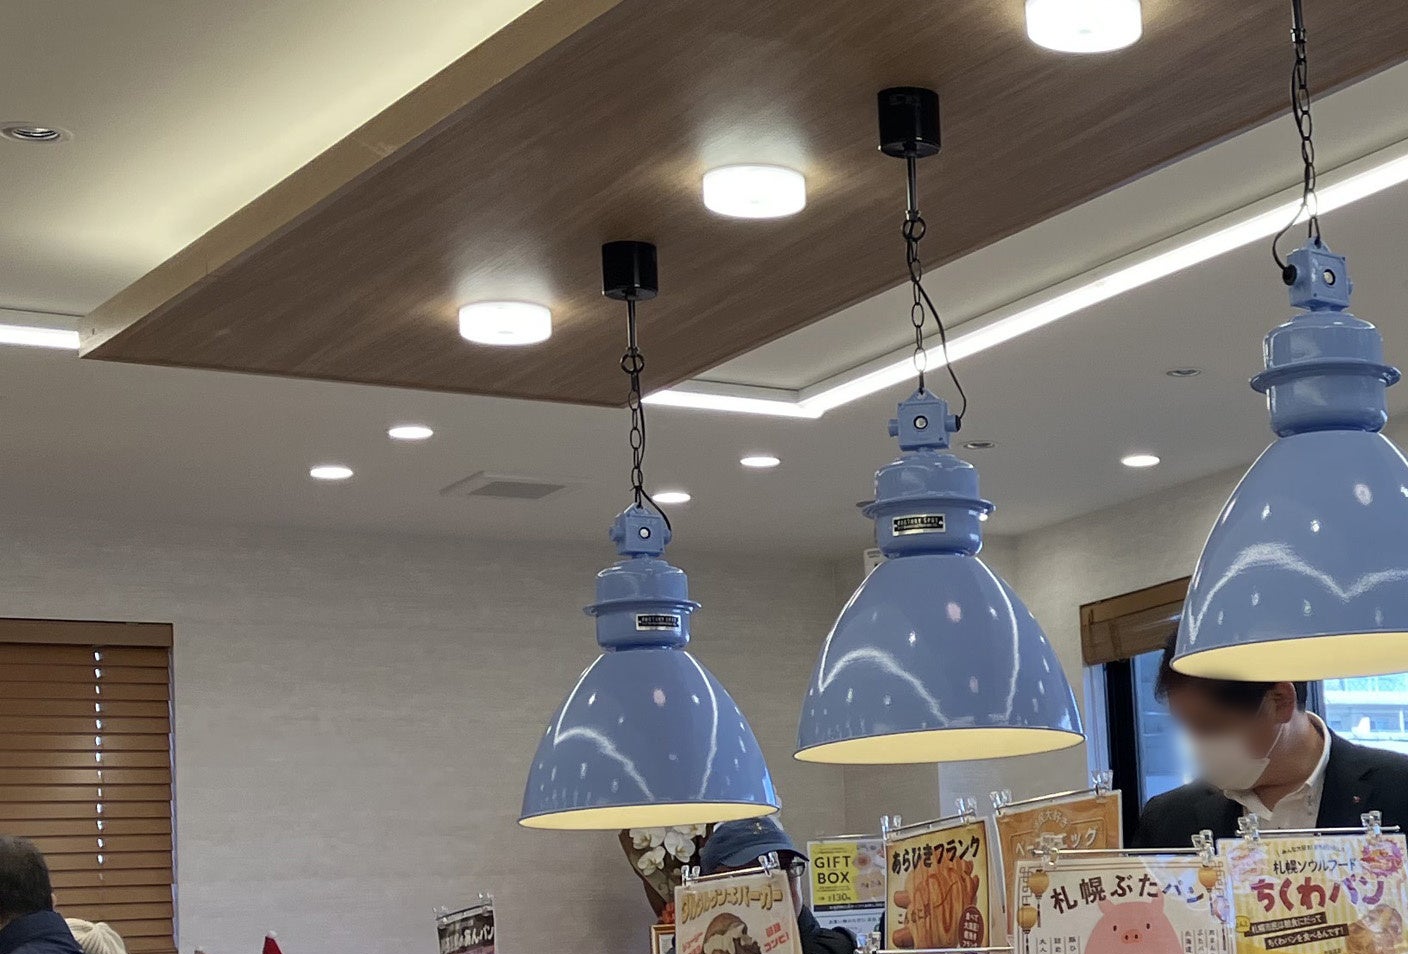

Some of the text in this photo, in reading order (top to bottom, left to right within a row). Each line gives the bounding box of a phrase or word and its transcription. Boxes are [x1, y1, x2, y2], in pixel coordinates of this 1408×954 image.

[814, 855, 851, 869] GIFT
[891, 836, 980, 874] あらびきフランク
[1273, 858, 1356, 875] 札幌ソウルフード
[817, 872, 850, 884] BOX
[1051, 874, 1204, 914] 札幌ぶたパン
[1251, 874, 1384, 912] ちくわパン
